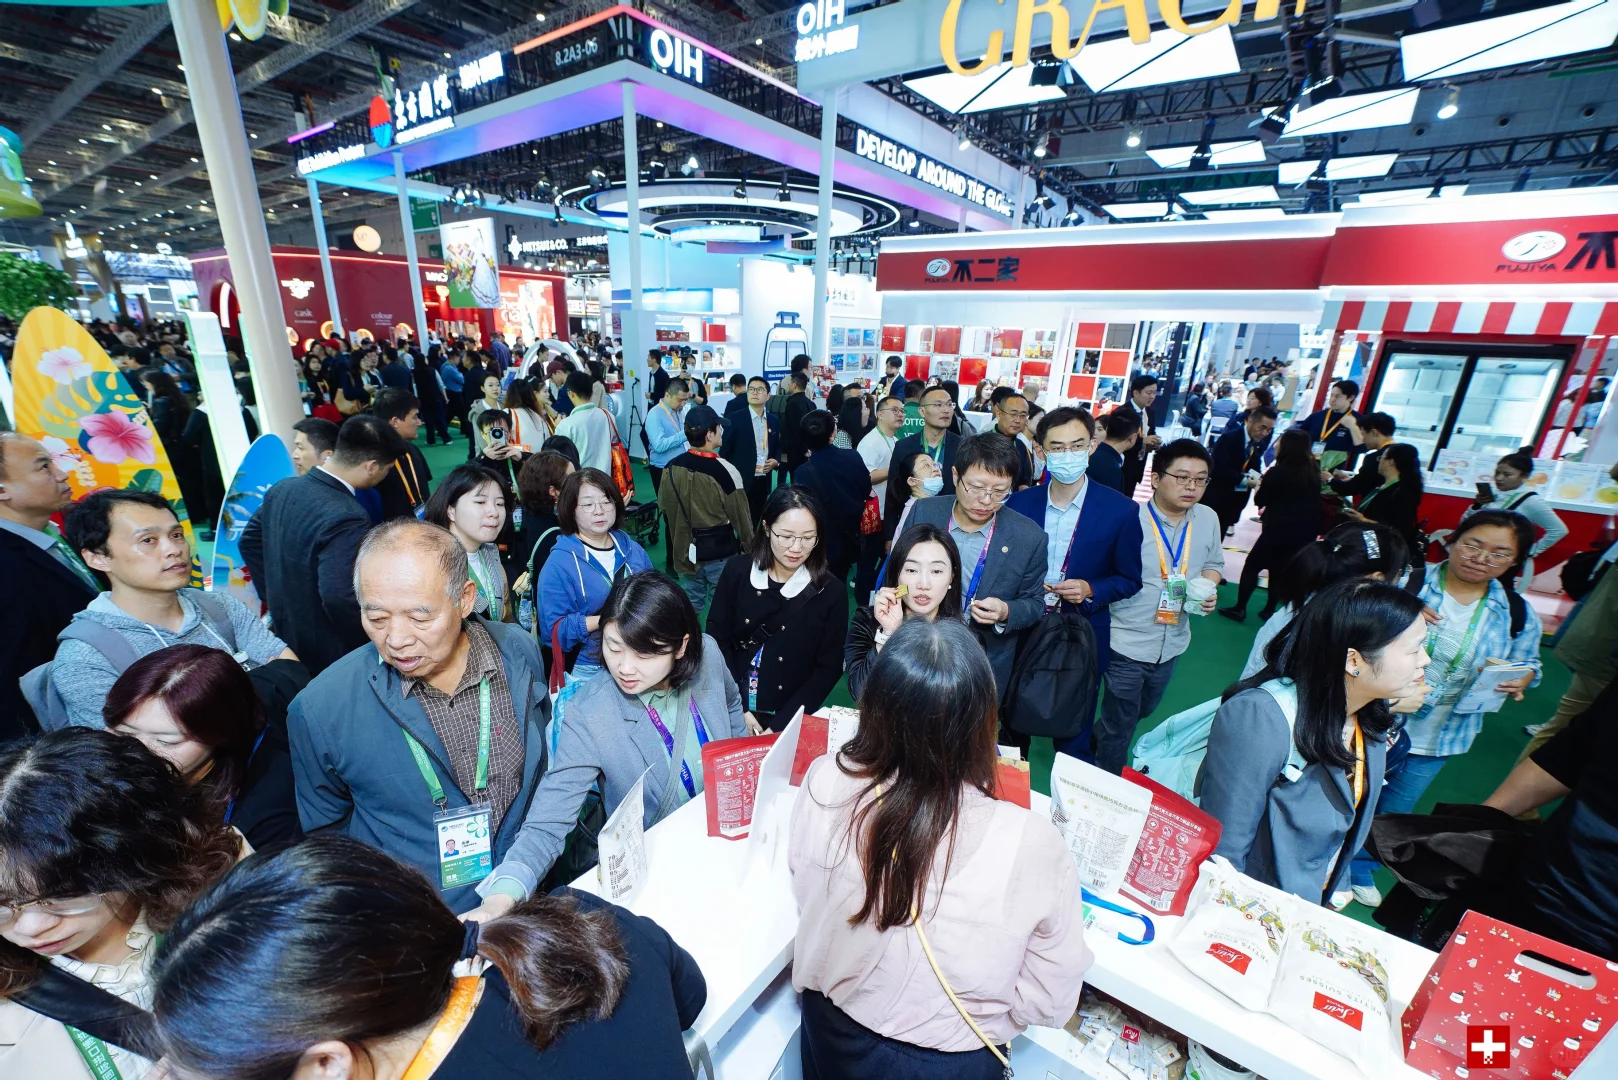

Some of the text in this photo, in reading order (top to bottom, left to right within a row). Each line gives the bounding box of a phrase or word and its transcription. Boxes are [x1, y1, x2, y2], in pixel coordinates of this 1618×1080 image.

[555, 37, 598, 67] 8.2A3-06
[650, 29, 703, 84] OIH
[856, 128, 917, 177] DEVELOP
[917, 157, 967, 198] AROUND
[967, 179, 986, 206] THE
[952, 257, 1020, 282] 不二家
[1495, 263, 1557, 273] FUJIYA
[371, 312, 393, 320] colour
[902, 417, 926, 427] OTTG
[1299, 975, 1342, 996] SUISSES
[1346, 994, 1382, 1016] PETITS
[72, 1027, 118, 1080] 国际进口博览
